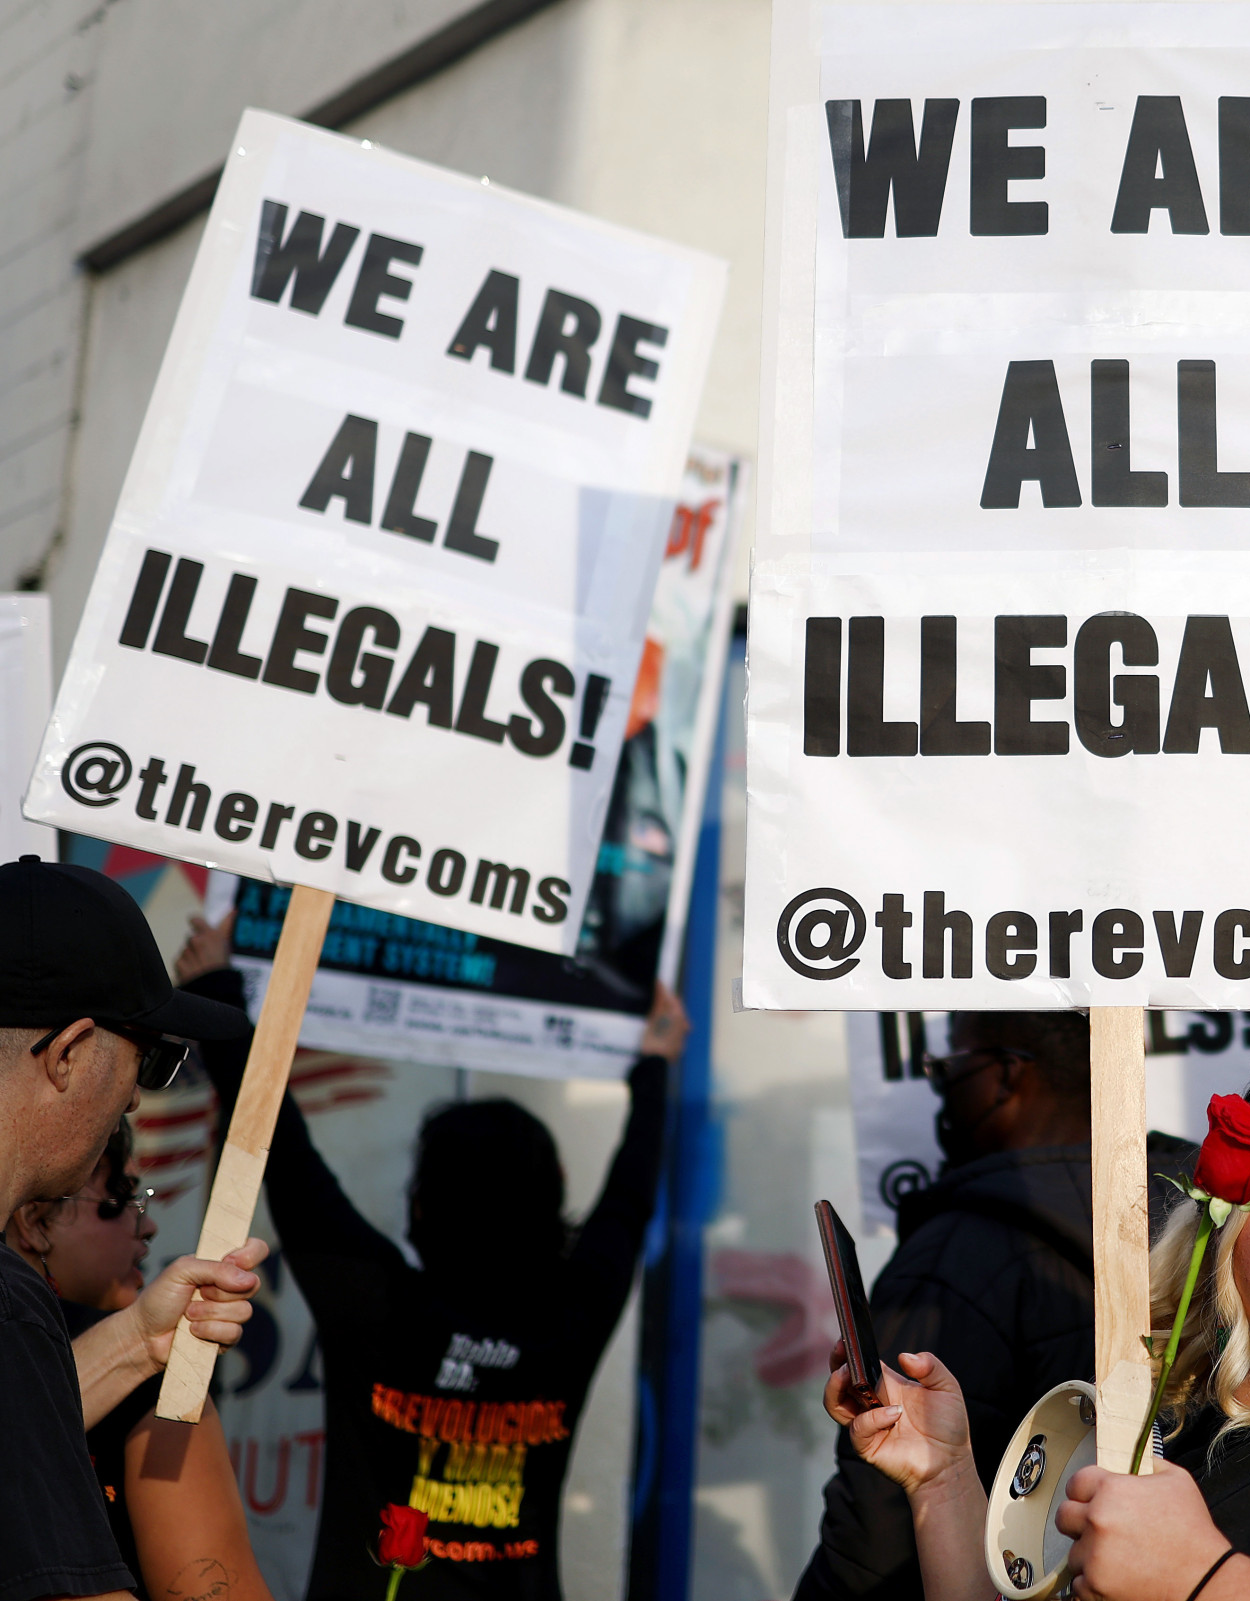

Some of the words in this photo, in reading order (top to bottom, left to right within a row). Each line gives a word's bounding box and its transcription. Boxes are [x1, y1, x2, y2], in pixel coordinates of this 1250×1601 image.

[825, 96, 1049, 239] WE
[249, 199, 424, 341] WE
[446, 269, 670, 419] ARE
[299, 414, 500, 563] ALL
[118, 549, 613, 770] ILLEGALS!
[61, 740, 572, 925] @therevcoms
